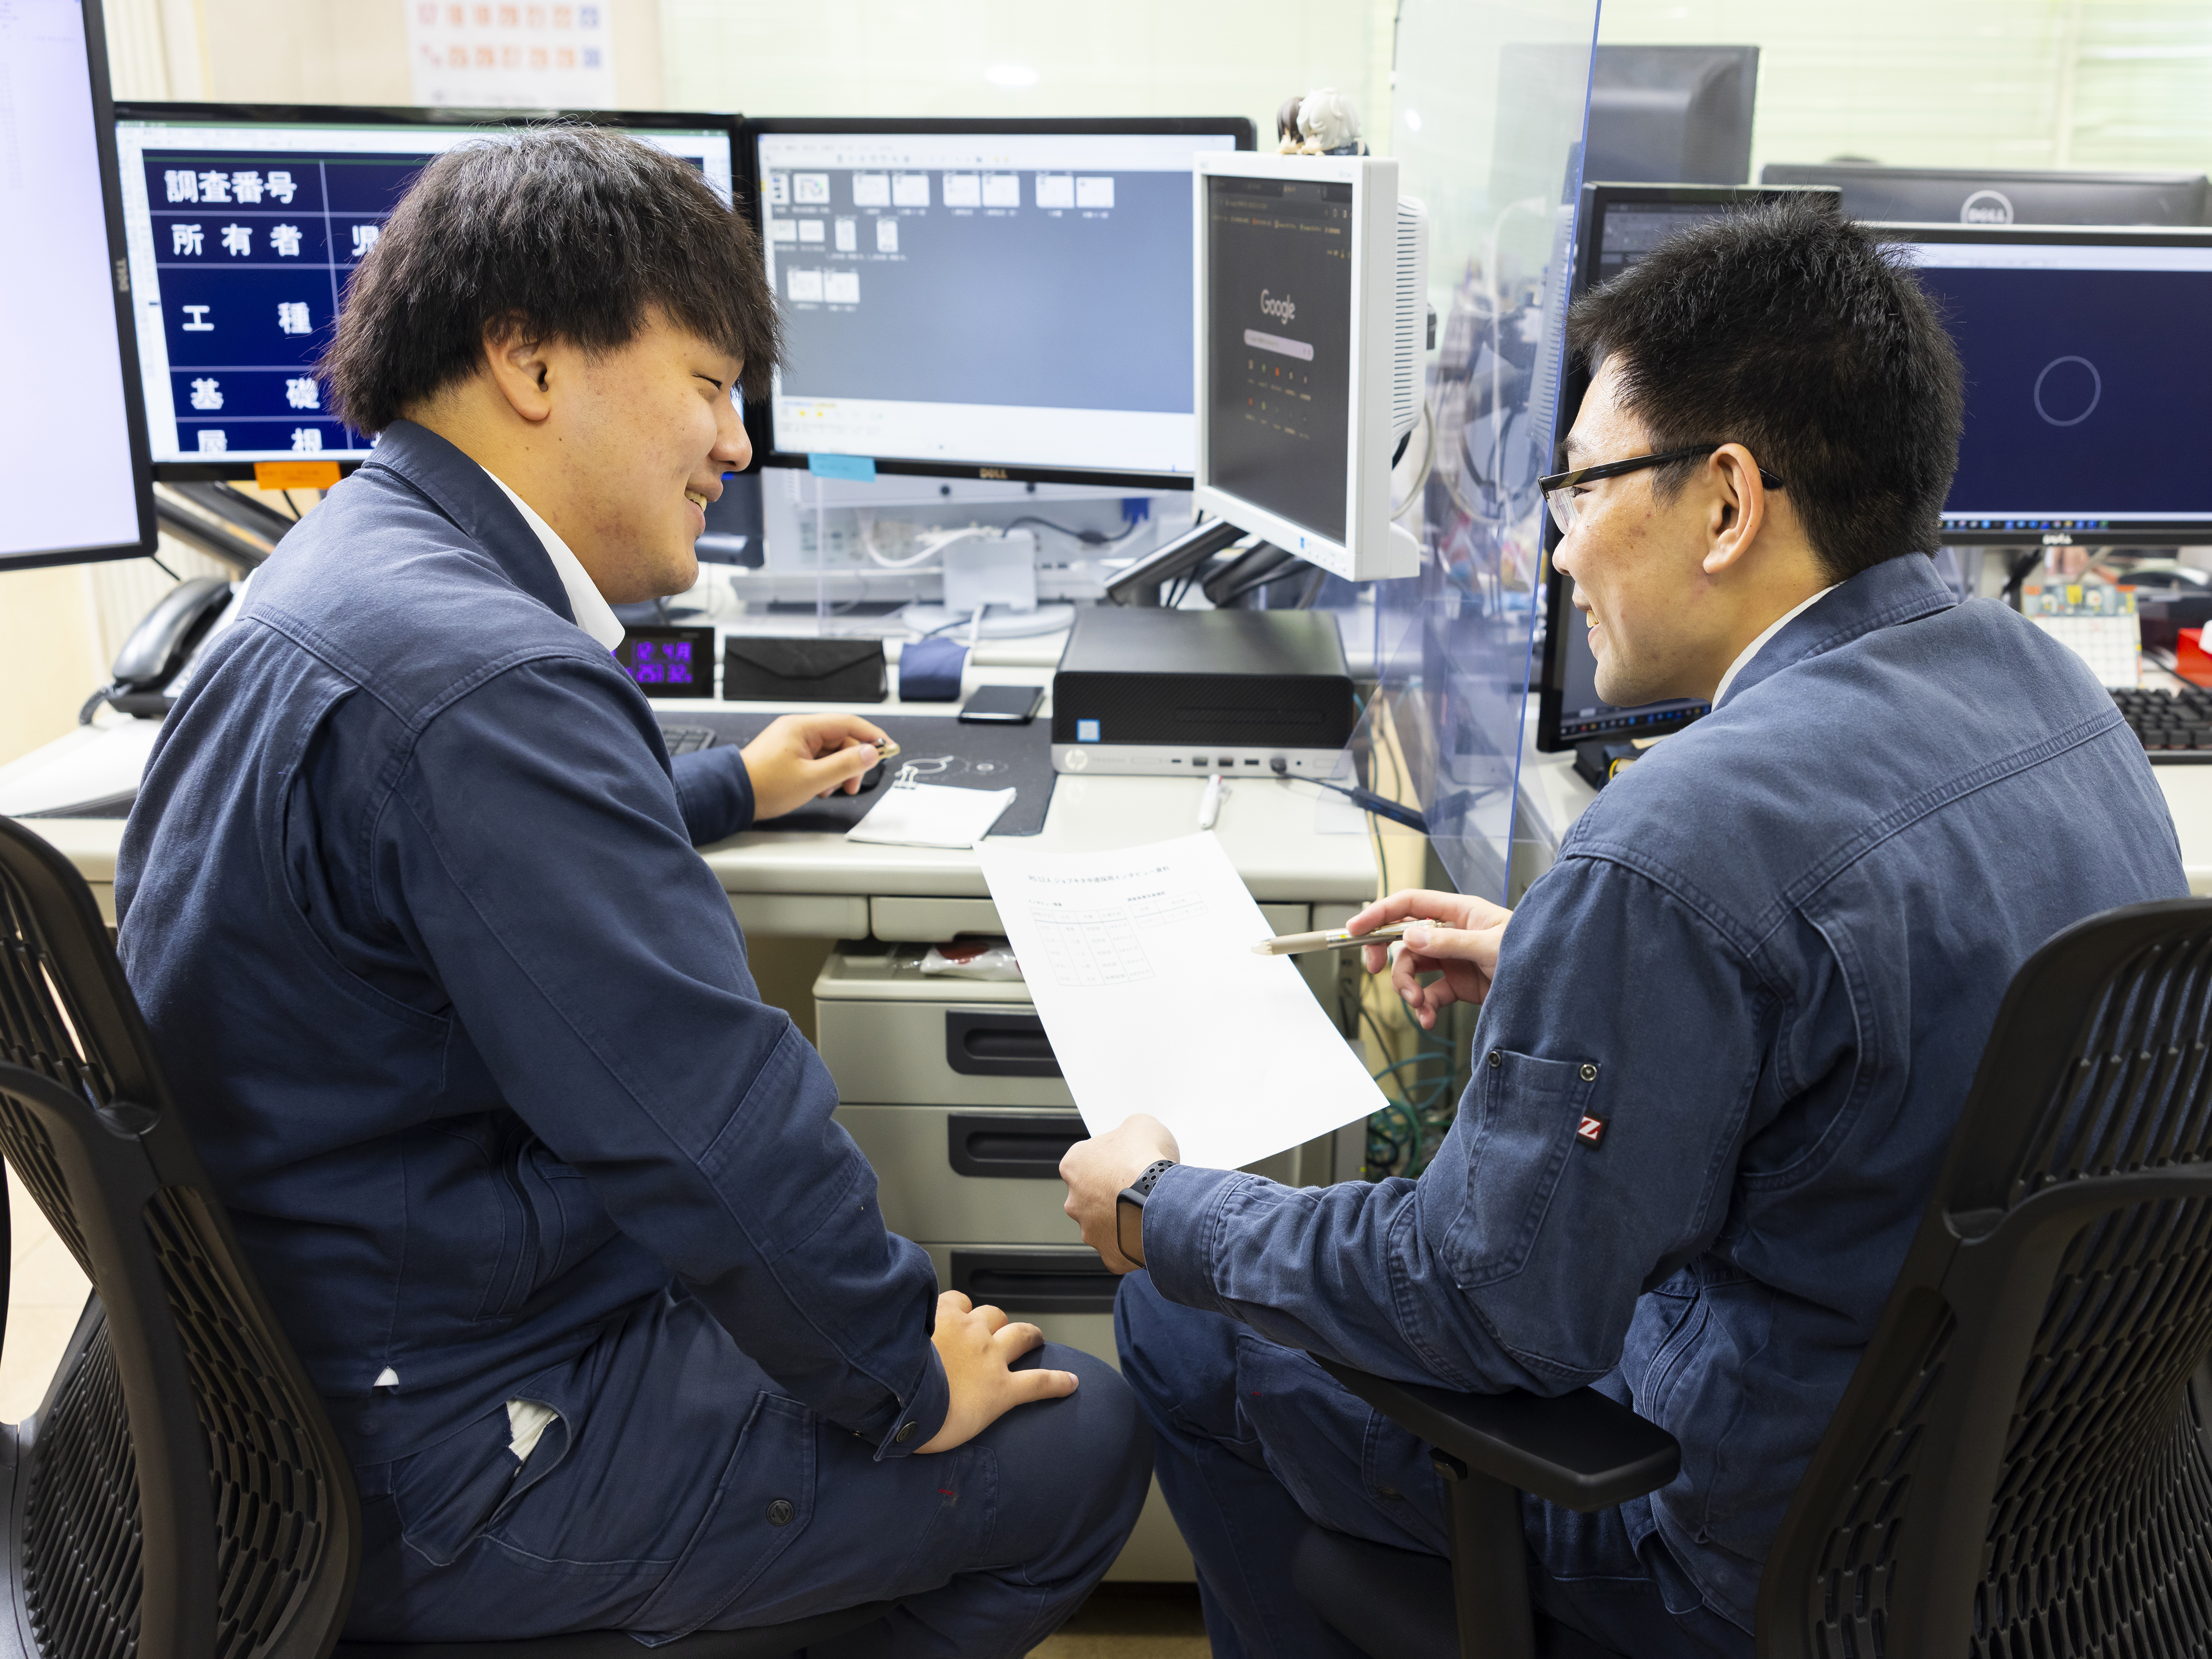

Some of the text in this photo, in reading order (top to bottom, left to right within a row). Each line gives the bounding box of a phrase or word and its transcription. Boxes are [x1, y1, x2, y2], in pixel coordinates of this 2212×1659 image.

[164, 170, 297, 204] 調査番号
[1260, 288, 1296, 325] Google
[980, 467, 1008, 479] DELL
[1065, 748, 1089, 772] hp
[1578, 1116, 1601, 1140] Z
